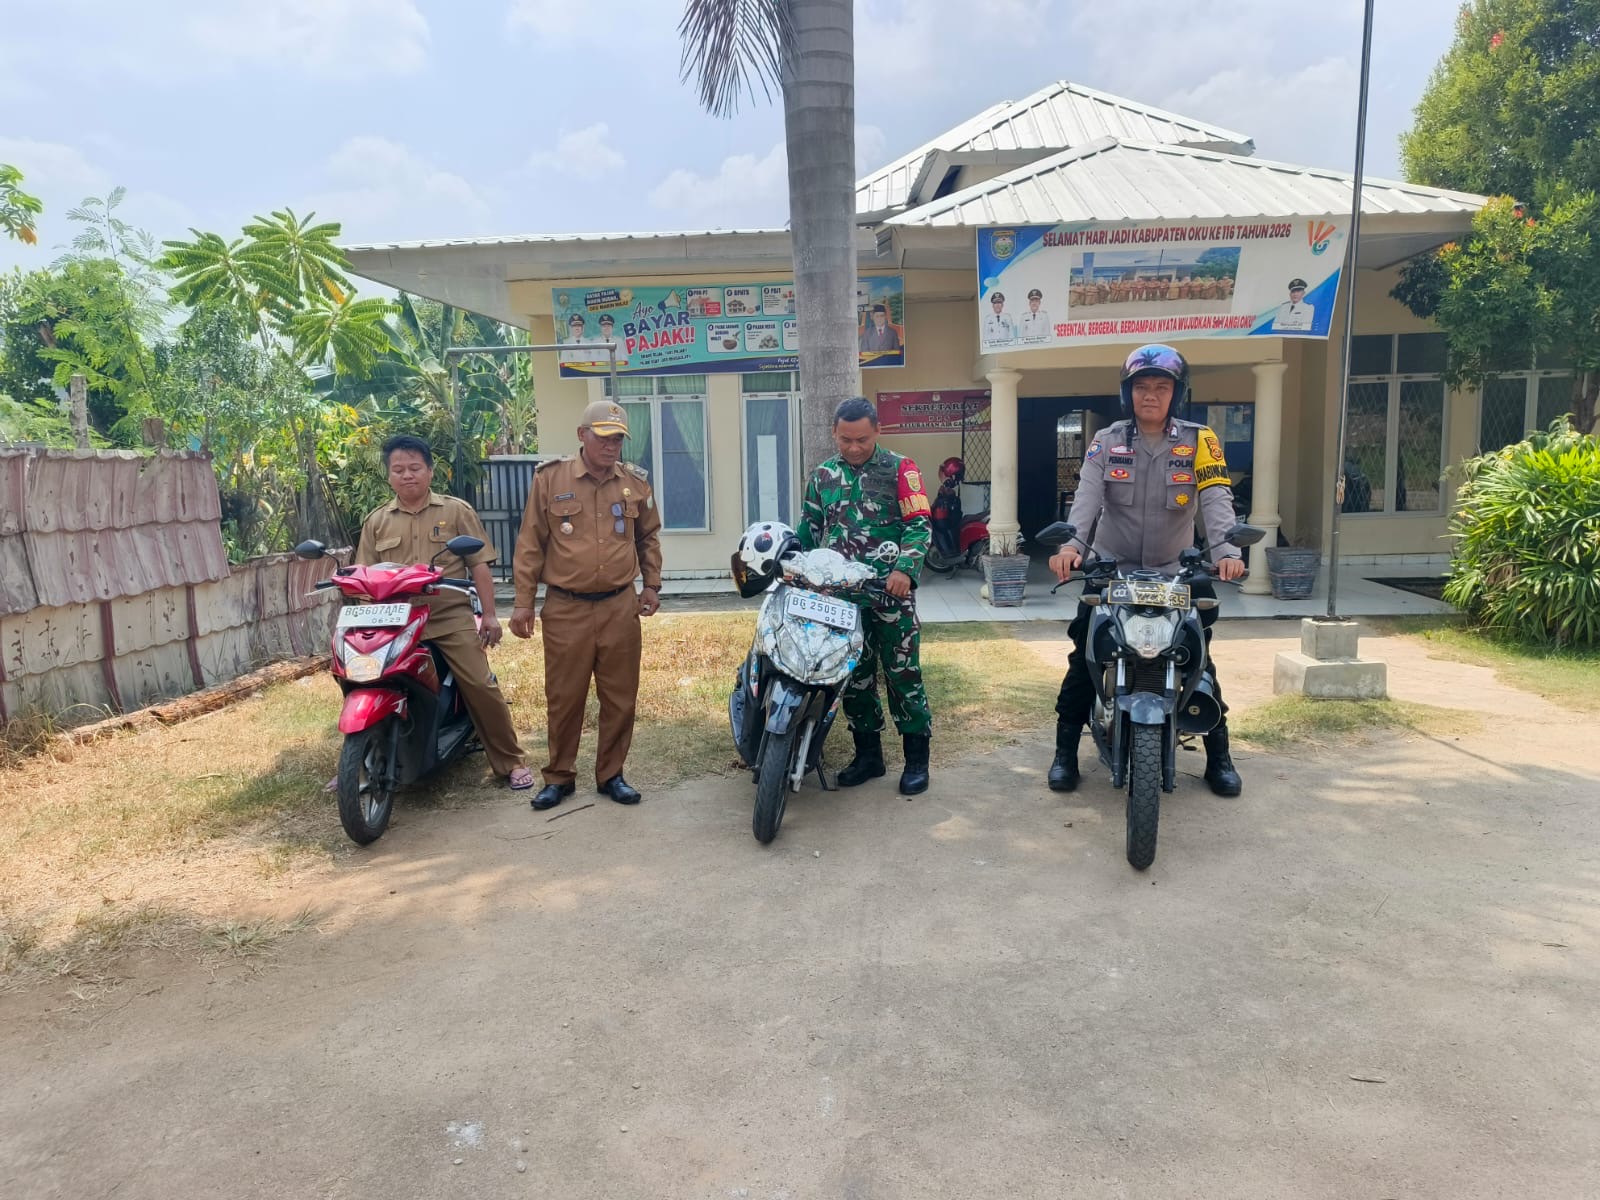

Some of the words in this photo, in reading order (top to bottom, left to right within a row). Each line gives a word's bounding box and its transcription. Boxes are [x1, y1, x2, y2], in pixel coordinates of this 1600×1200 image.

[1043, 231, 1085, 248] SELAMAT
[1085, 229, 1108, 245] HARI
[1109, 228, 1131, 244] JADI
[1131, 226, 1186, 243] KABUPATEN
[1187, 225, 1208, 241] OKU
[1208, 225, 1220, 241] KE
[1222, 224, 1235, 240] 116
[1236, 223, 1269, 240] TAHUN
[1269, 223, 1292, 239] 2026
[632, 301, 654, 320] Ayo
[623, 311, 690, 338] BAYAR
[1088, 320, 1119, 336] BERGERAK,
[1120, 319, 1156, 334] BERDAMPAK
[1157, 318, 1178, 332] NYATA
[1178, 315, 1211, 331] WUJUDKAN
[625, 326, 695, 355] PAJAK!!
[902, 402, 978, 412] SEKRETARIAT
[1168, 459, 1193, 468] POLRI
